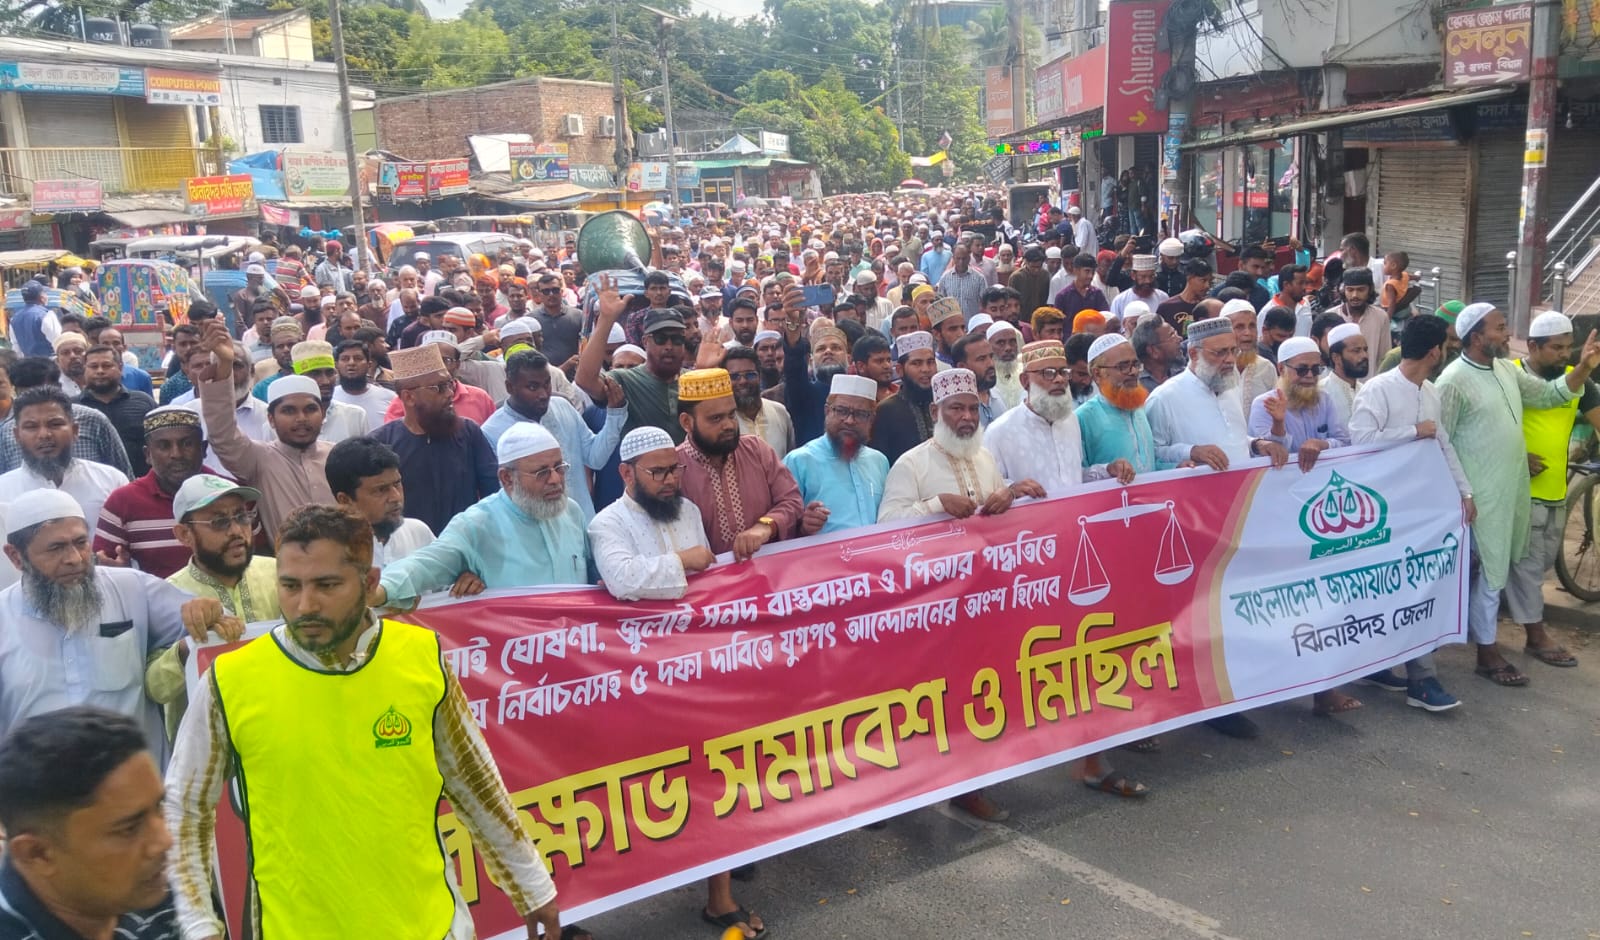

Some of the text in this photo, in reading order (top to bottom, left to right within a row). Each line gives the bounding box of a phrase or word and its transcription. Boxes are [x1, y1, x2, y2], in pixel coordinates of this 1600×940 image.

[150, 77, 195, 89] COMPUTER
[195, 80, 220, 91] POINT
[1119, 9, 1156, 102] Shwapno
[1446, 22, 1531, 58] সেলুন
[616, 604, 695, 654] জুলাই
[700, 596, 758, 627] সনদ
[765, 573, 871, 617] বাস্তবায়ন
[878, 569, 895, 593] ও
[904, 553, 975, 589] পিআর
[982, 529, 1057, 573] পদ্ধতিতে
[1230, 532, 1459, 627] বাংলাদেশ জামায়াতে ইসলামী
[497, 670, 623, 725] নির্বাচনসহ
[630, 665, 648, 694] ৫
[657, 651, 702, 686] দফা
[710, 631, 773, 674] দাবিতে
[779, 621, 836, 668] যুগপৎ
[844, 597, 959, 643] আন্দোলনের
[964, 586, 1008, 619] অংশ
[1011, 574, 1062, 609] হিসেবে
[1291, 598, 1436, 657] ঝিনাইদহ জেলা
[703, 677, 951, 818] সমাবেশ
[963, 667, 1008, 742] ও
[1016, 612, 1179, 730] মিছিল
